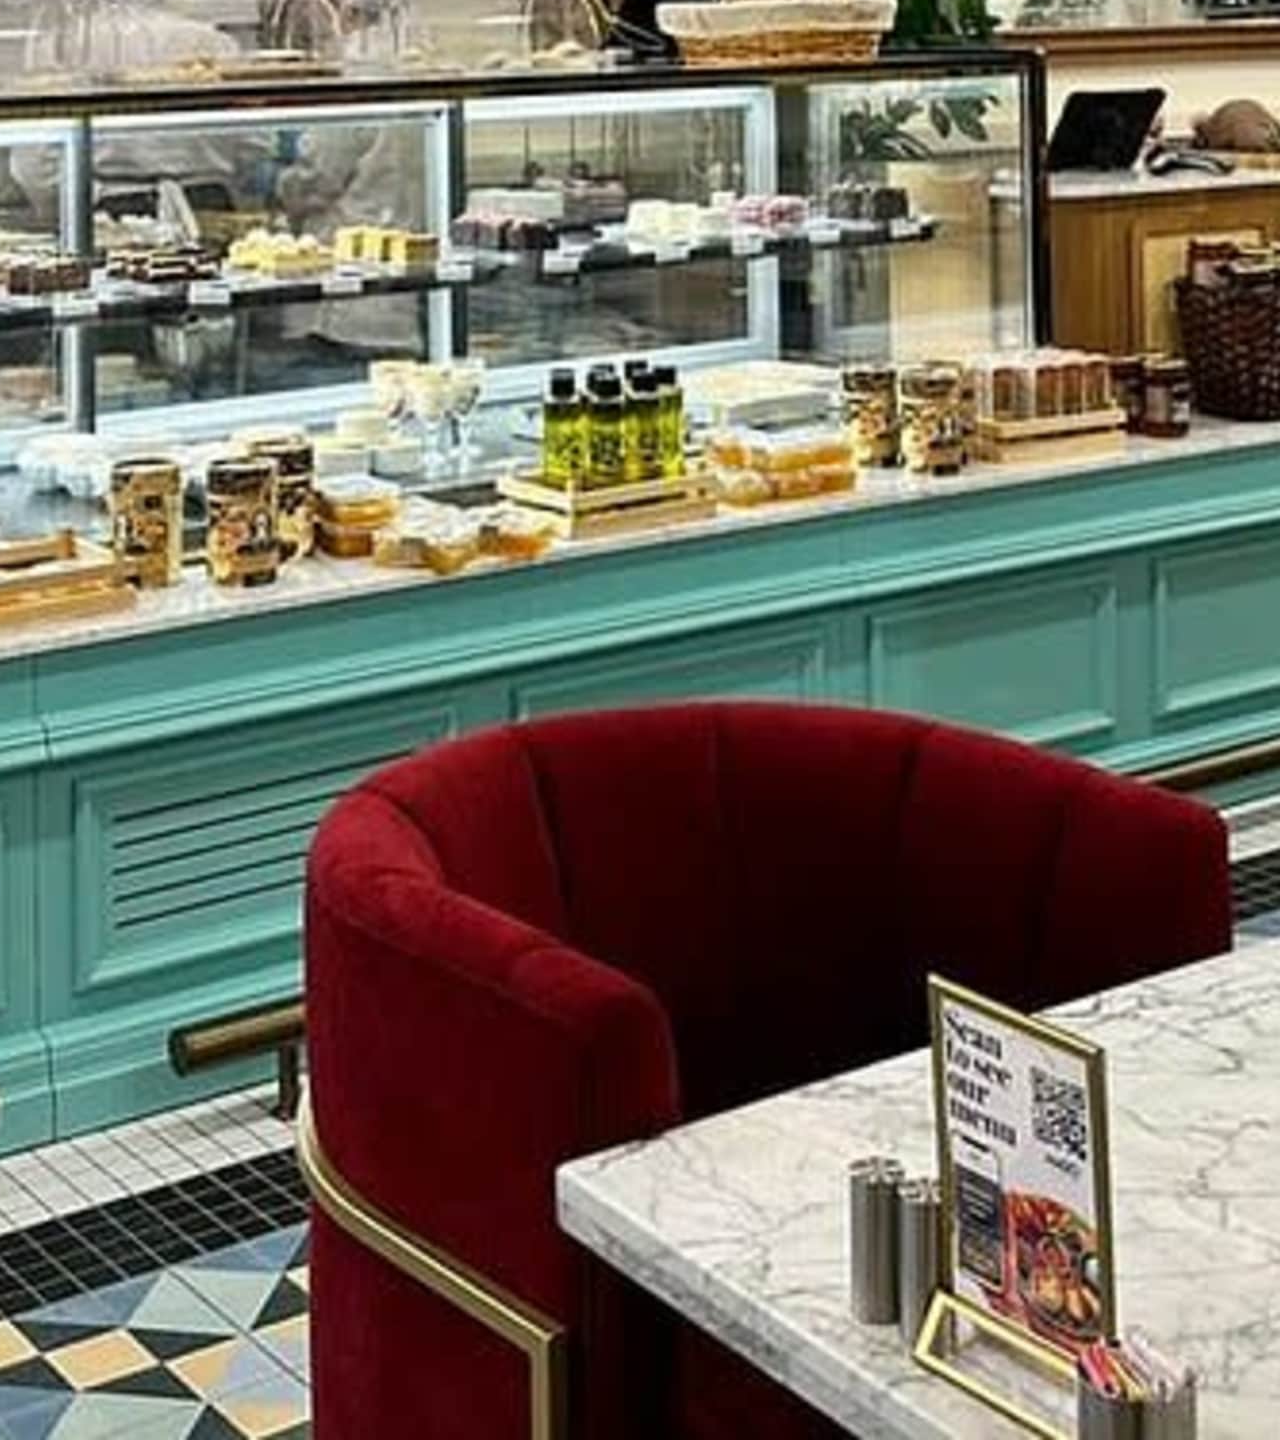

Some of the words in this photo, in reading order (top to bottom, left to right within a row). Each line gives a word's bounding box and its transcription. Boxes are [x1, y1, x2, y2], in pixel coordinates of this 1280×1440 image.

[944, 1010, 1003, 1061] Scan
[946, 1038, 970, 1071] to
[973, 1058, 1013, 1088] see
[946, 1071, 991, 1106] our
[950, 1097, 1017, 1147] menu
